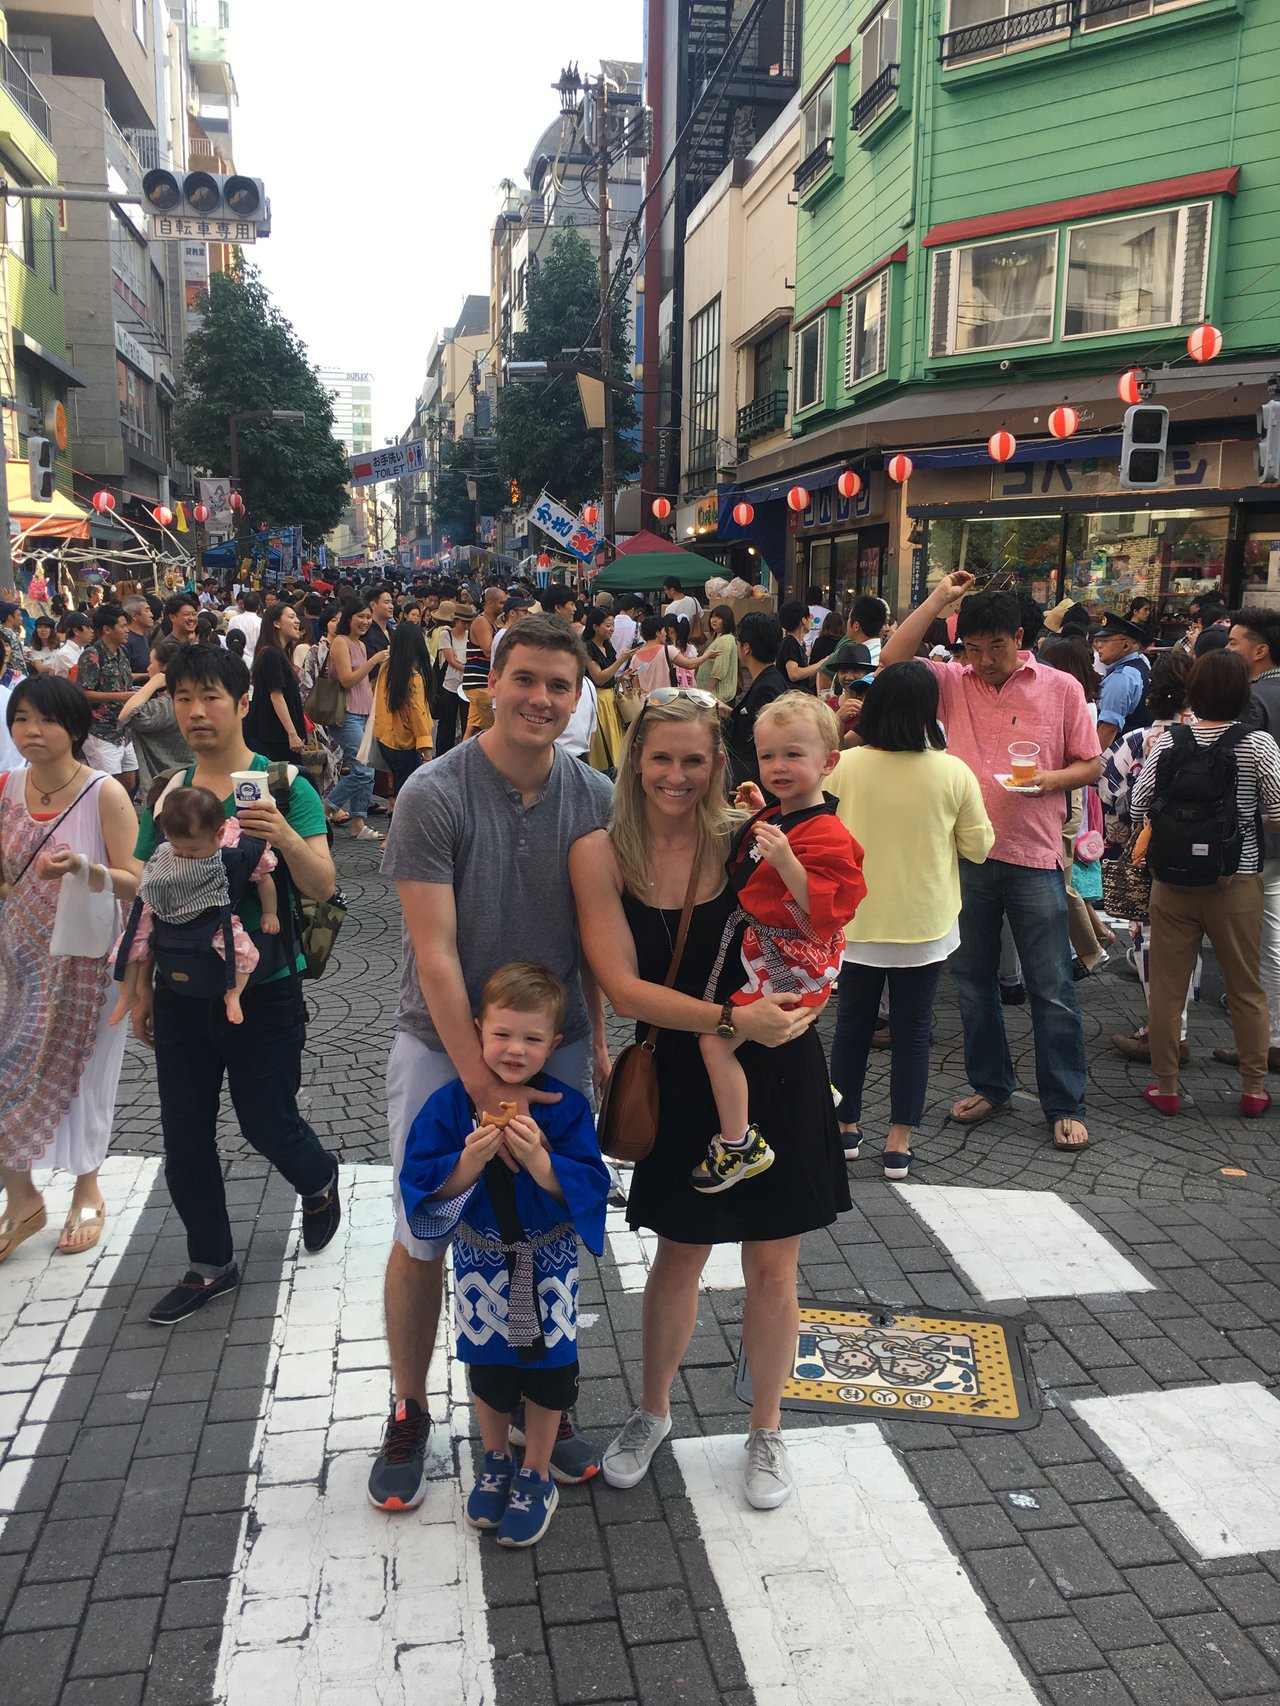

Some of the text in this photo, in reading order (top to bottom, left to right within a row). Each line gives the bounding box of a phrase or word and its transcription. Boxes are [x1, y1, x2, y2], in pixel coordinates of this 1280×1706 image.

[160, 217, 250, 240] 自転車専用
[373, 451, 404, 467] お手洗い
[375, 464, 405, 479] TOILET
[1002, 450, 1208, 495] コバシ
[536, 502, 598, 557] かき氷
